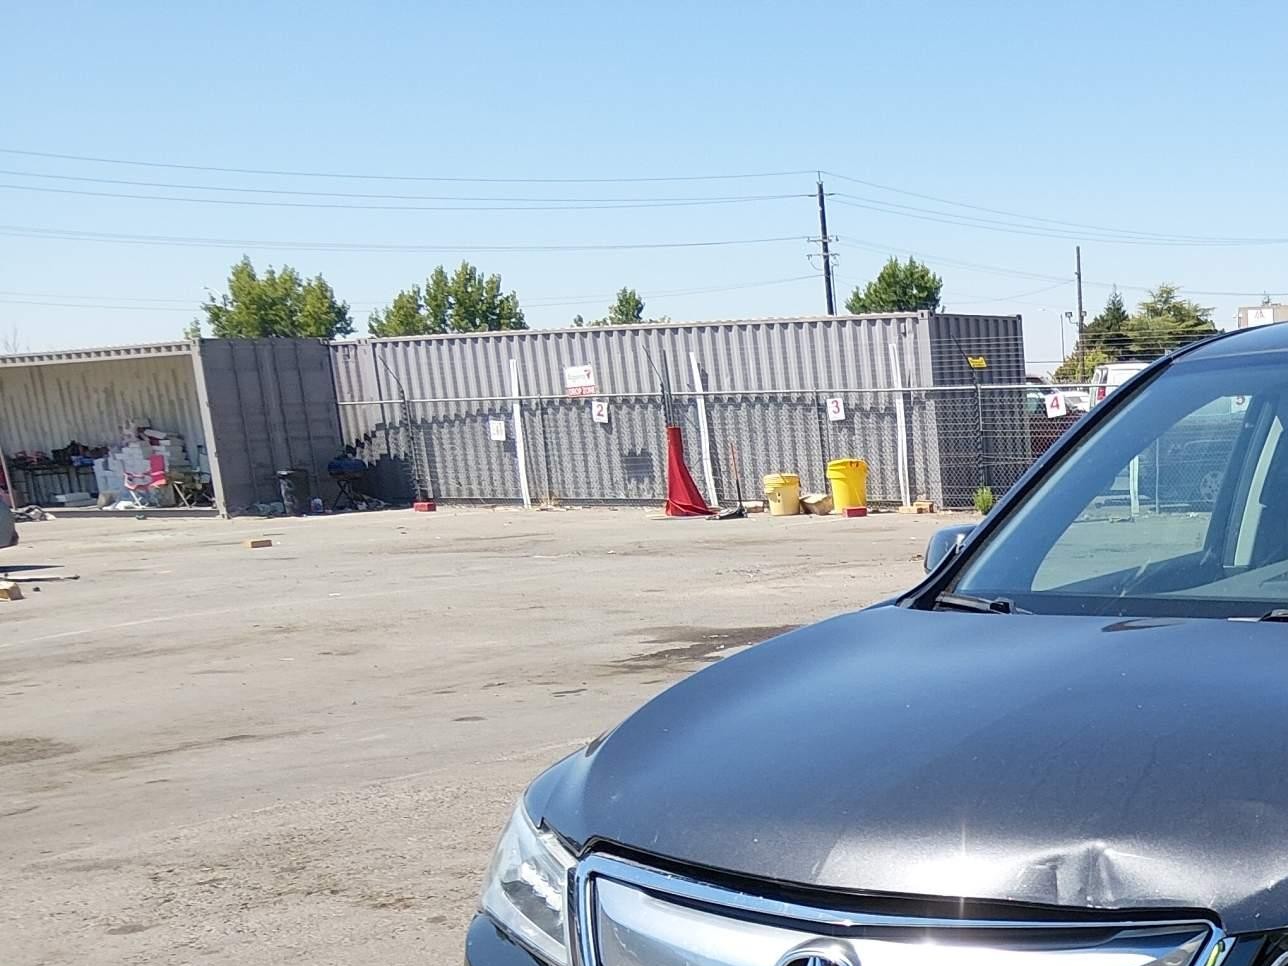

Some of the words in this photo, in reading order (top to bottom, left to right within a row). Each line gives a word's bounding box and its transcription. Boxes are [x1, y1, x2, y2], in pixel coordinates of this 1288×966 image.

[596, 403, 605, 417] 2
[831, 399, 841, 414] 3
[1050, 396, 1060, 410] 4
